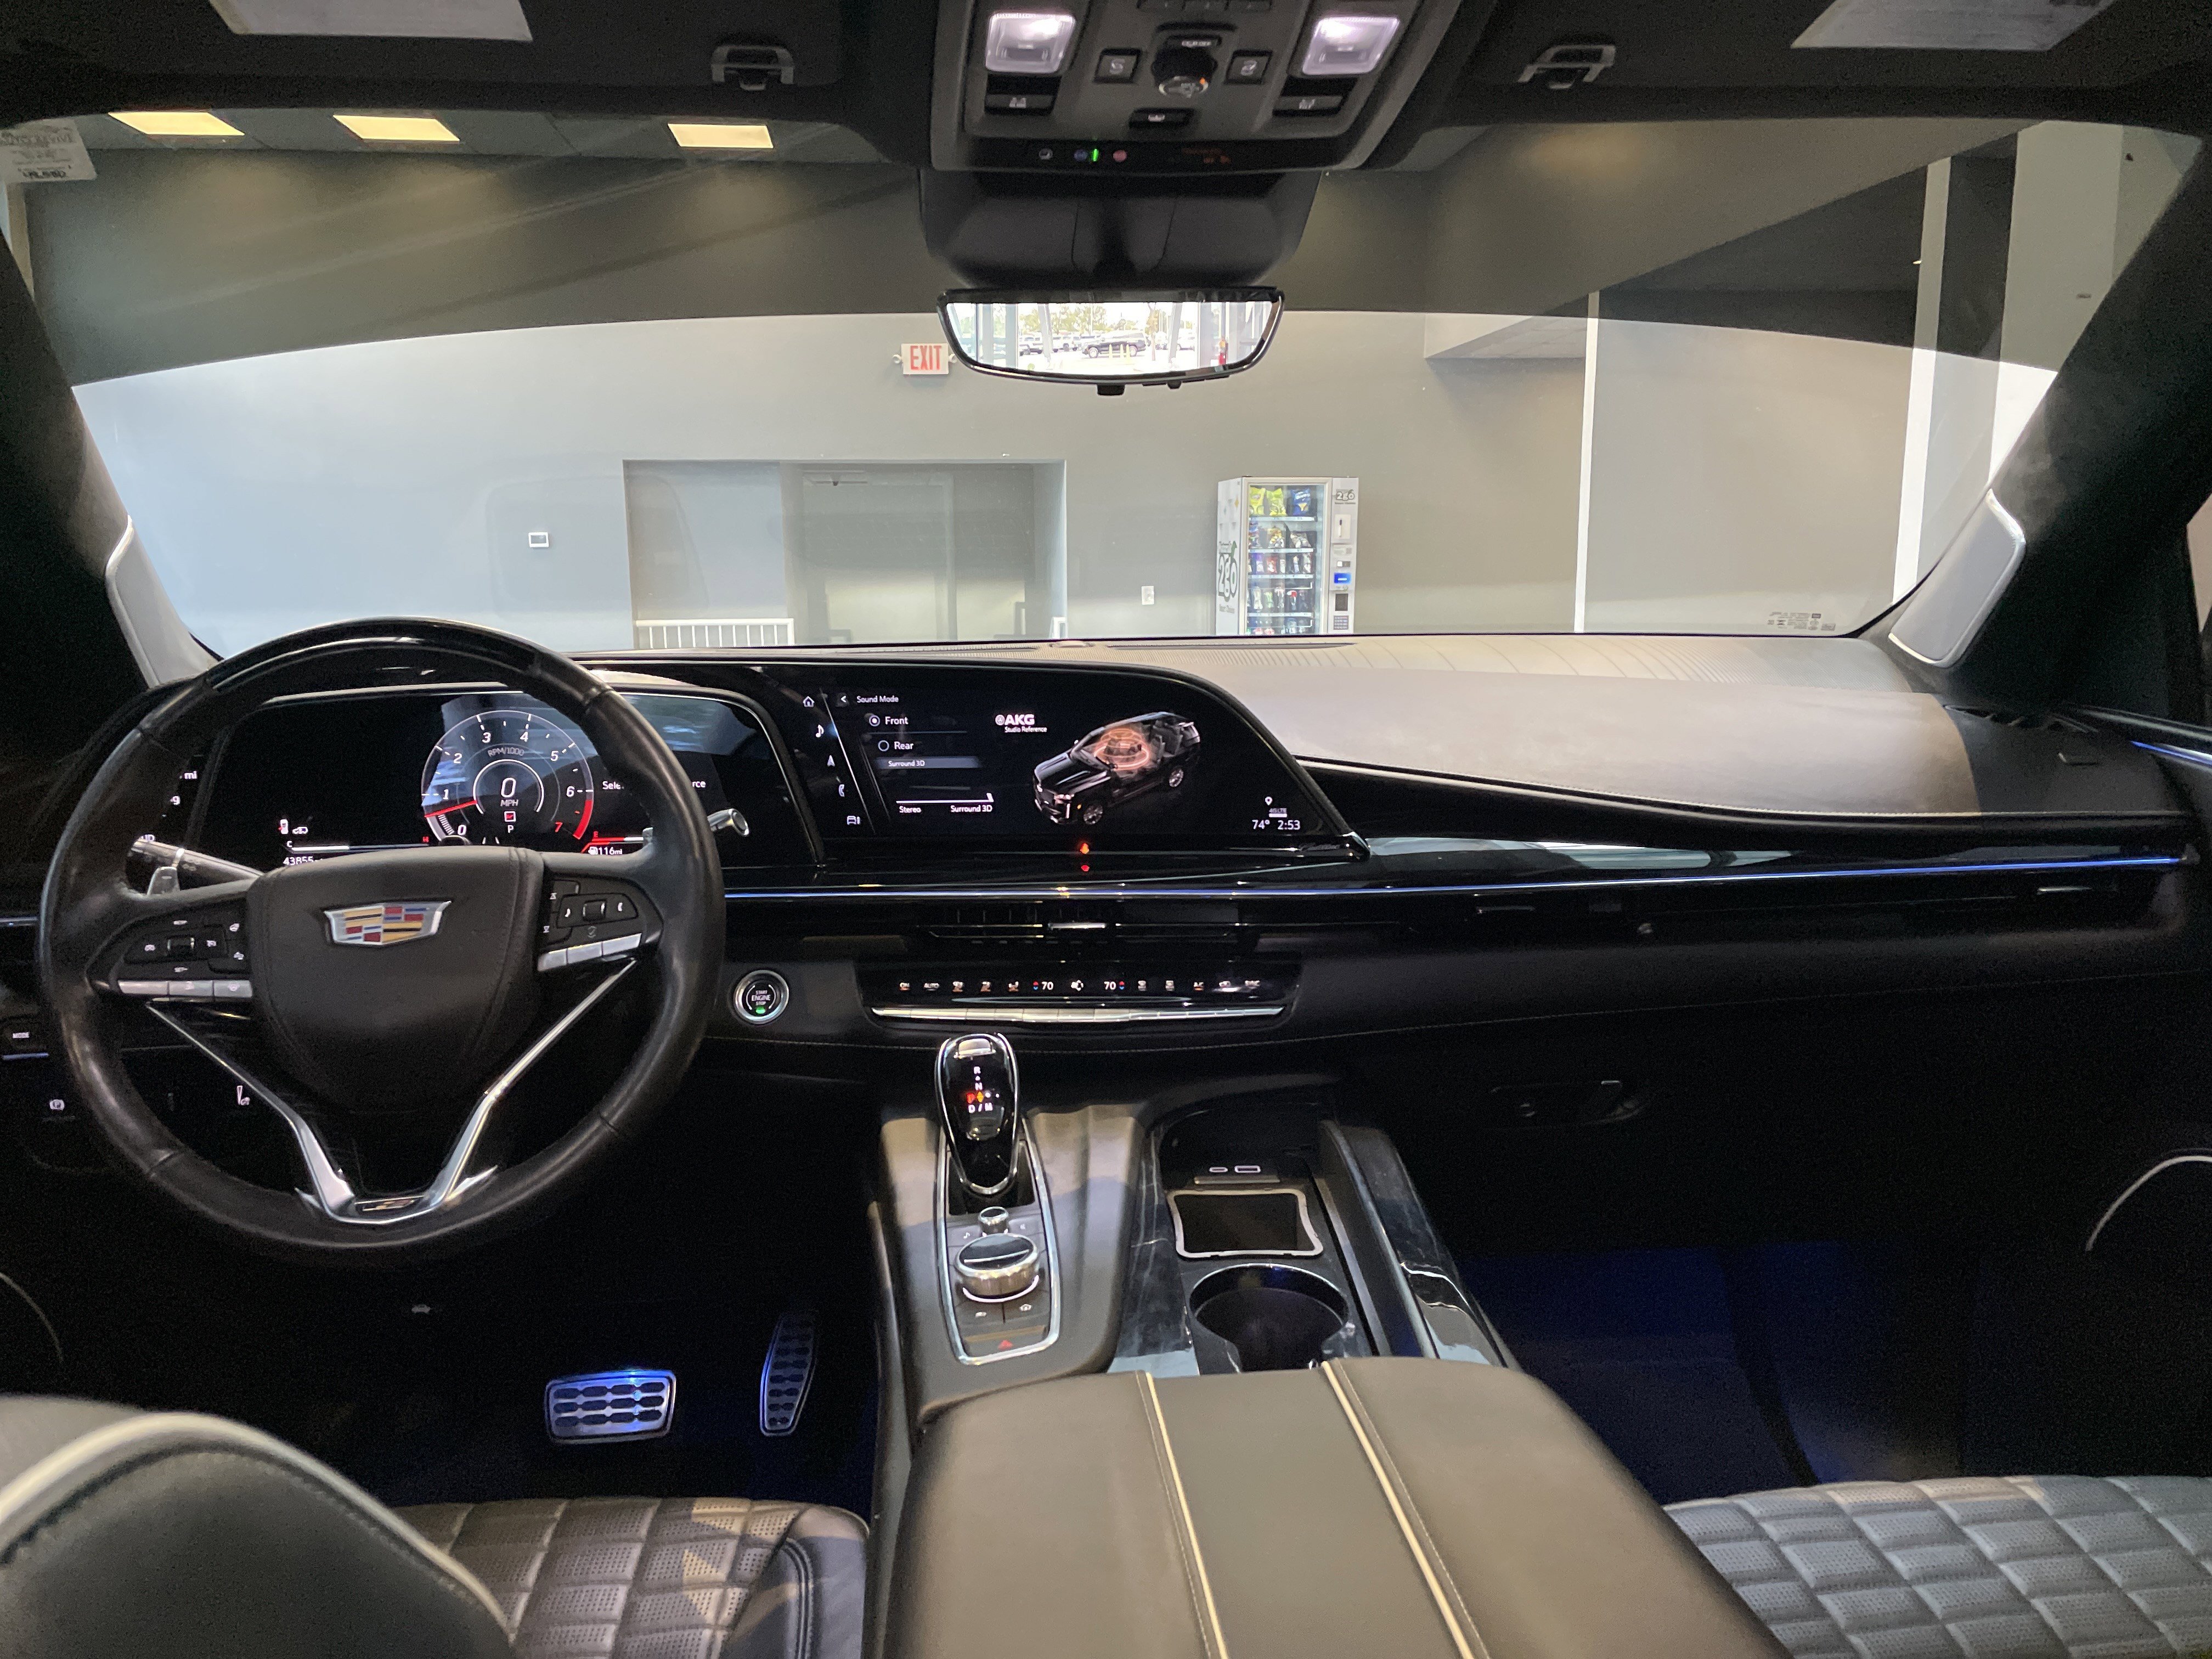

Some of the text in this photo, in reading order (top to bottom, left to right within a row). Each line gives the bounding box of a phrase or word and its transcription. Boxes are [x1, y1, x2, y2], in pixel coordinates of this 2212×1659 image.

[910, 346, 942, 370] EXIT
[885, 716, 909, 725] Front
[1005, 714, 1035, 725] AKG
[482, 732, 492, 743] 3
[520, 731, 529, 742] 4
[894, 742, 914, 750] Rear
[487, 747, 524, 757] RPM/1000
[550, 751, 558, 762] 5
[453, 753, 462, 764] 2
[500, 777, 516, 797] 0
[566, 786, 575, 797] 6
[443, 788, 449, 800] 1
[500, 799, 519, 807] MPH
[555, 822, 563, 832] 7
[1252, 819, 1301, 830] 74° 2:53
[458, 825, 466, 836] 0
[1041, 981, 1054, 990] 70
[1104, 981, 1116, 990] 70
[975, 1082, 983, 1091] N
